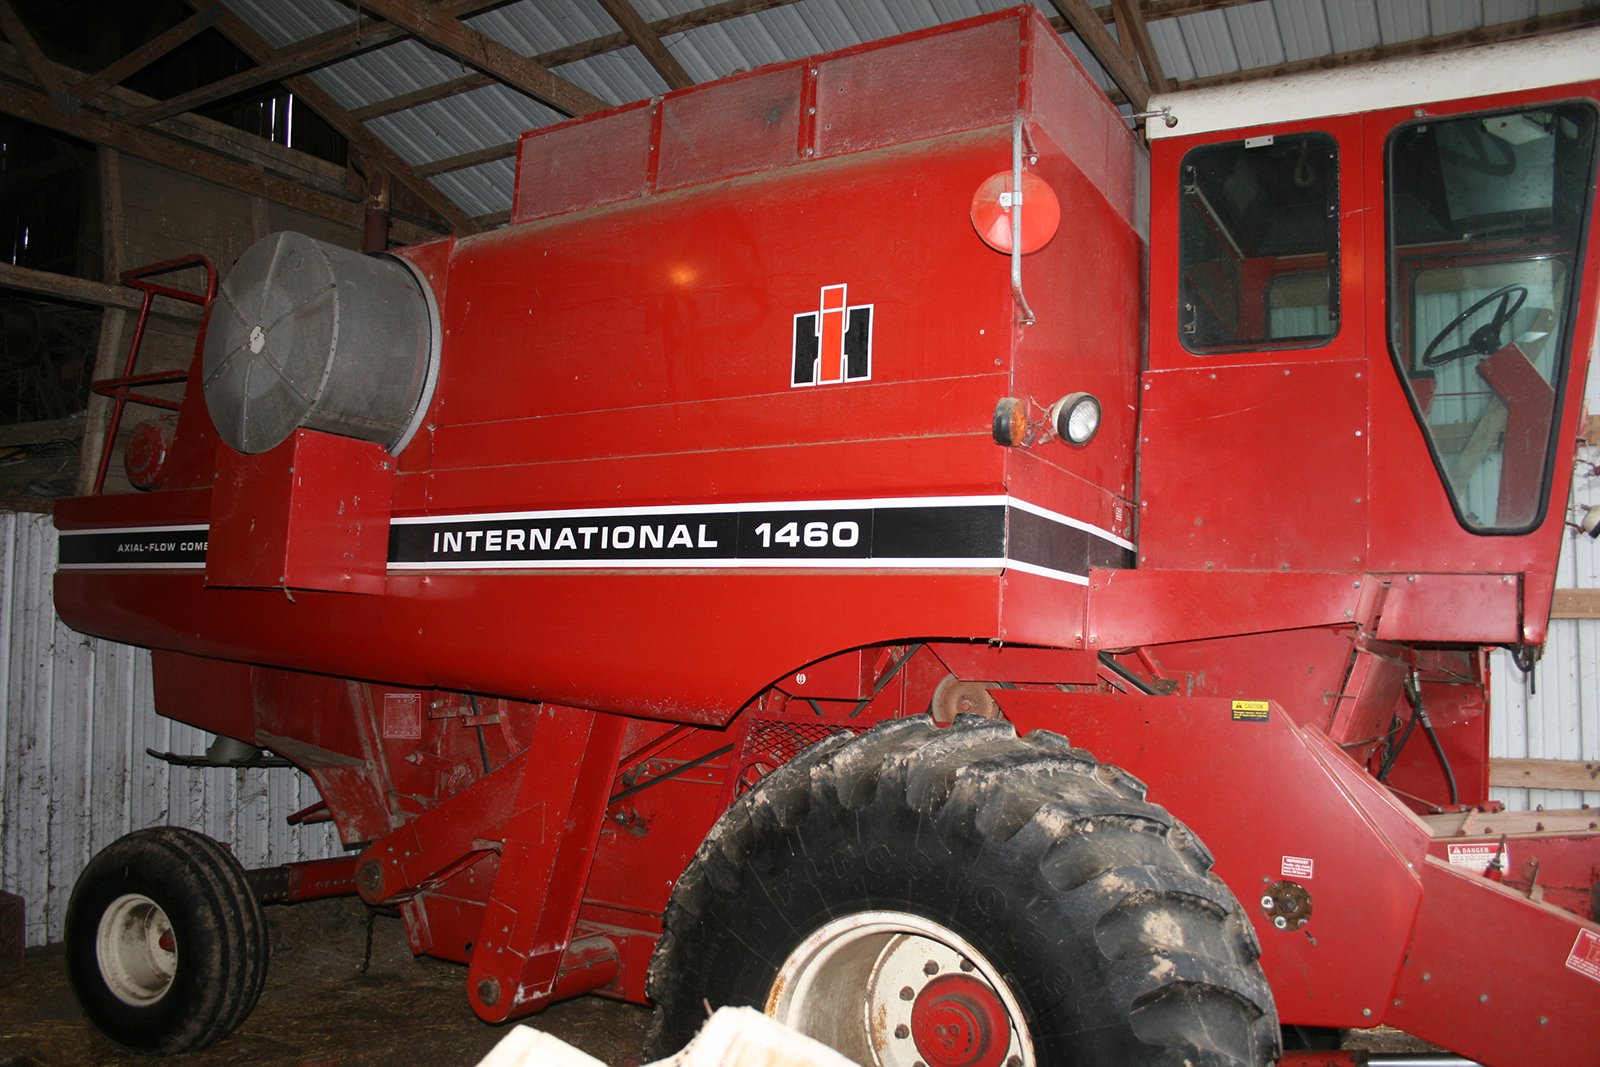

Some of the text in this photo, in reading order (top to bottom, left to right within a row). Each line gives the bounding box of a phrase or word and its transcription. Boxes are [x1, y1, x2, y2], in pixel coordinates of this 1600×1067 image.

[432, 521, 860, 553] INTERNATIONAL 1460
[117, 543, 176, 553] AXIAL-FLOW
